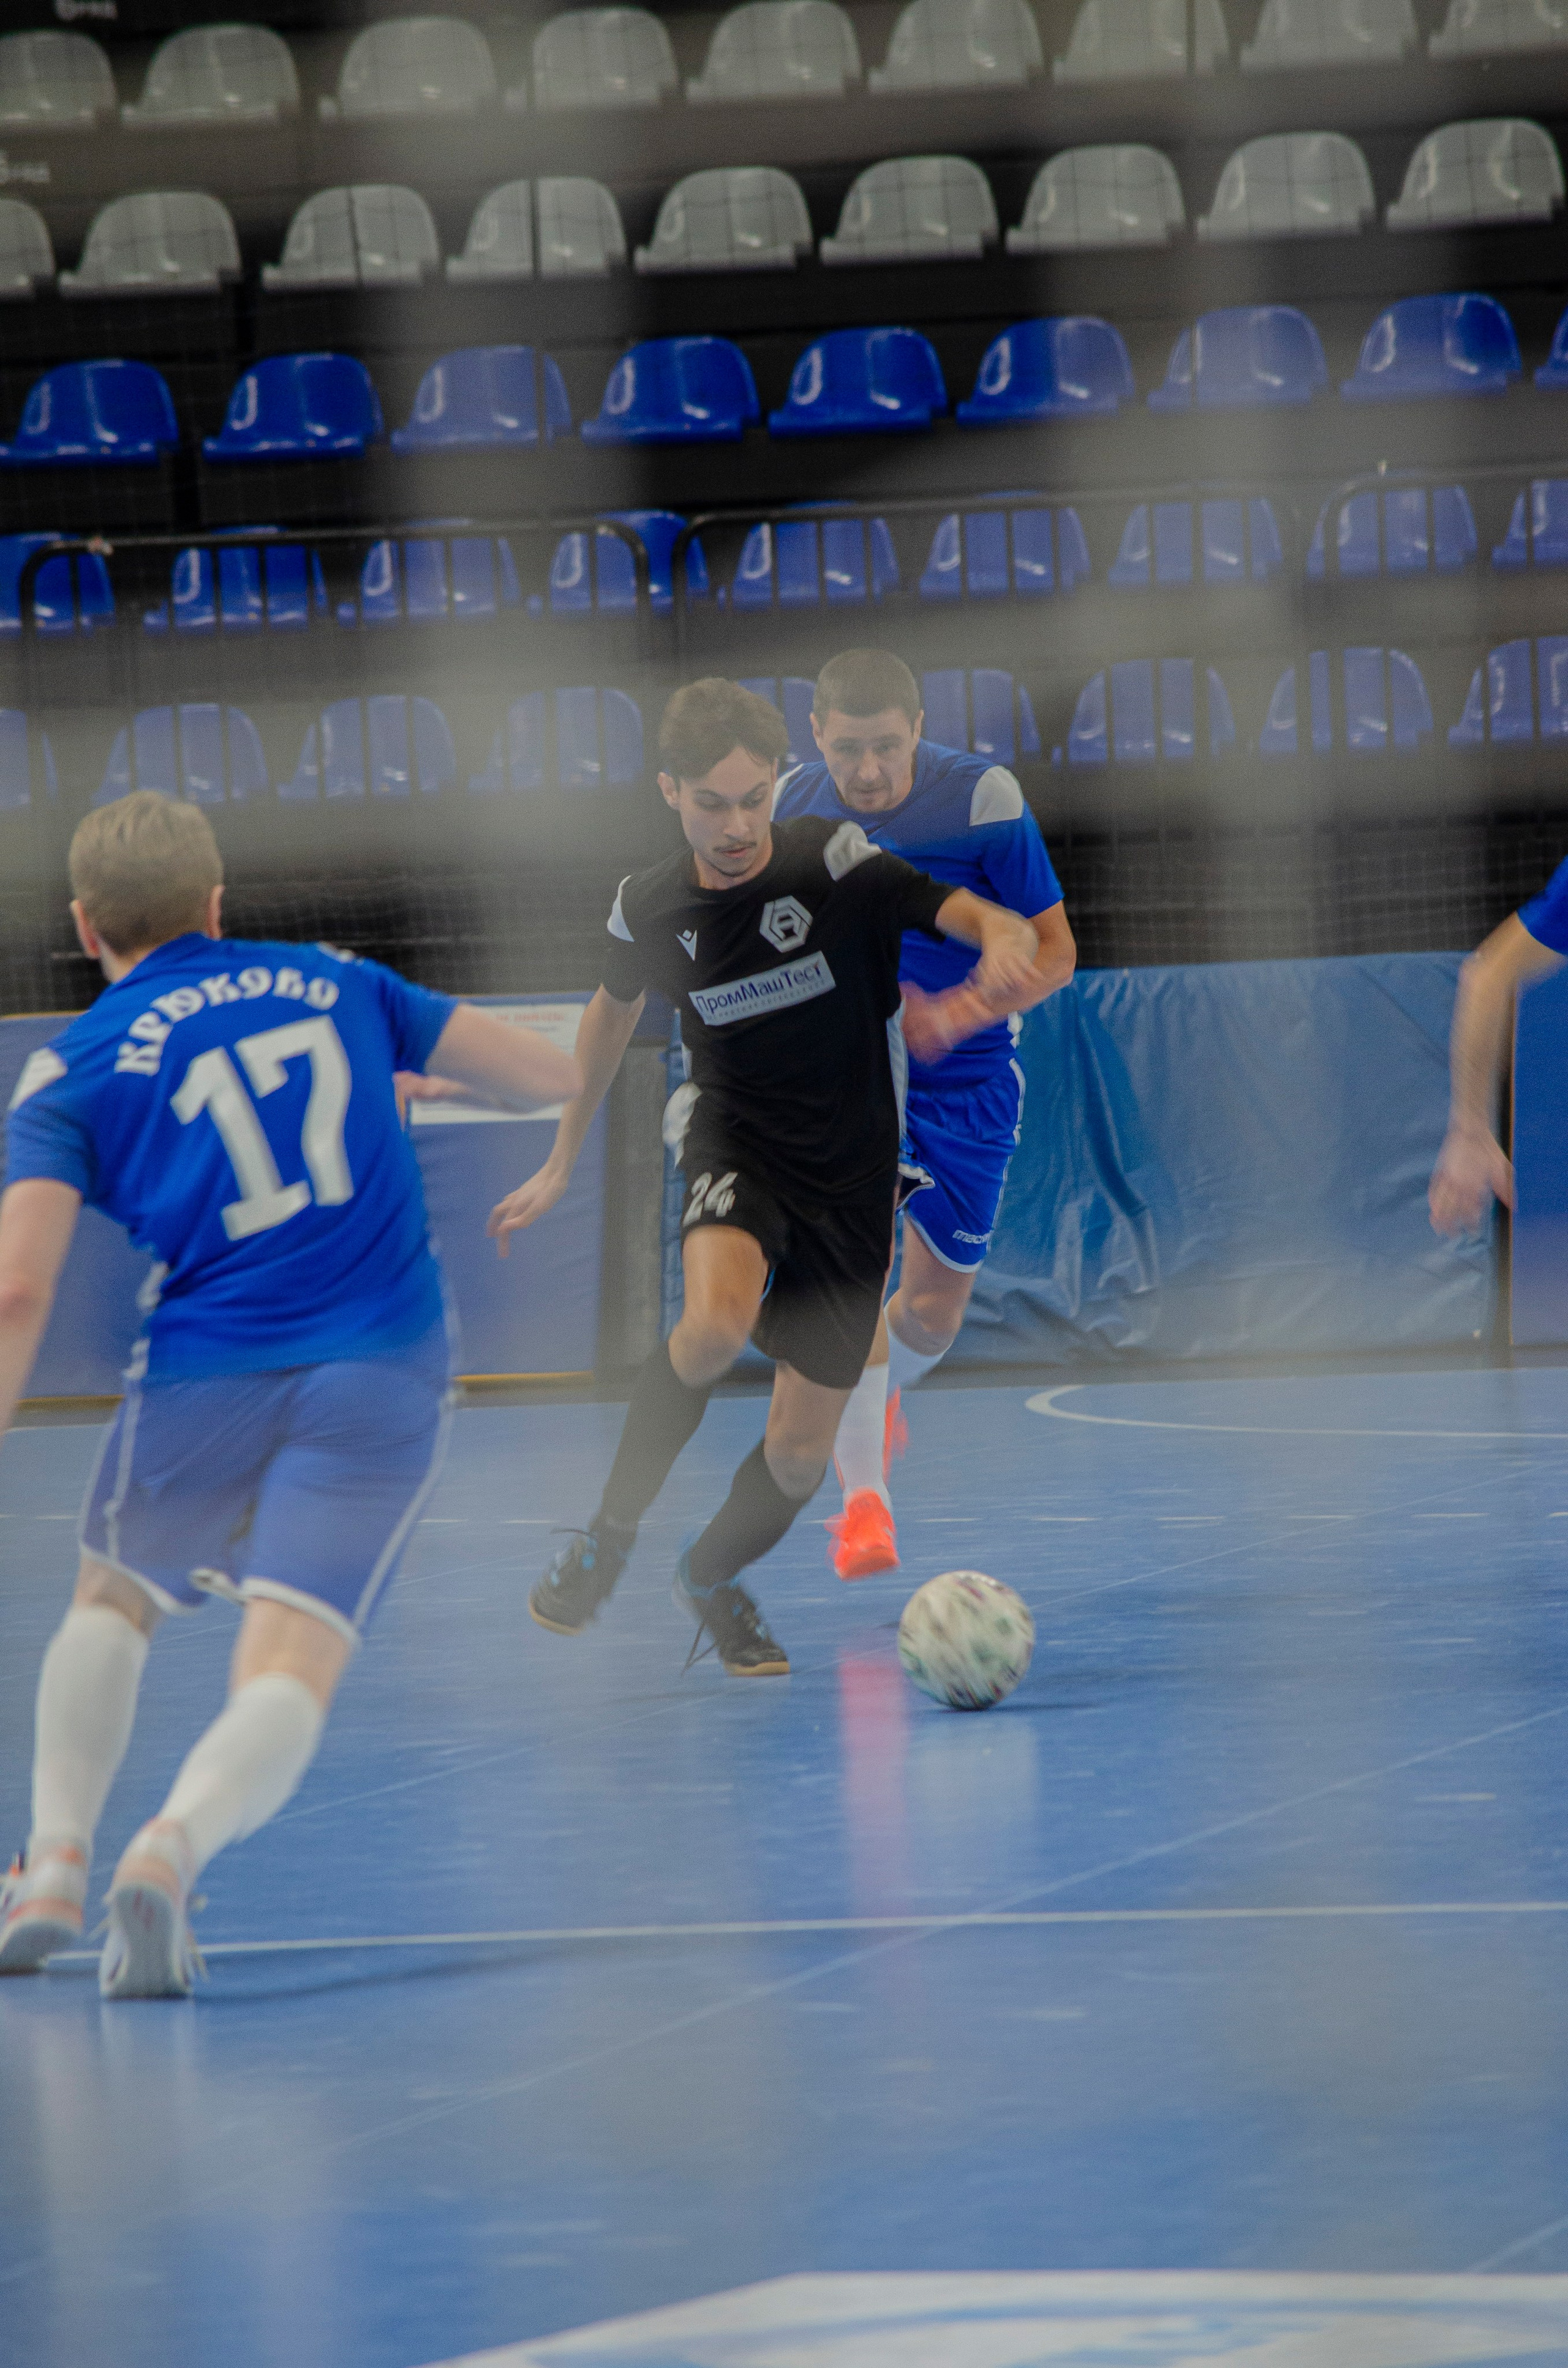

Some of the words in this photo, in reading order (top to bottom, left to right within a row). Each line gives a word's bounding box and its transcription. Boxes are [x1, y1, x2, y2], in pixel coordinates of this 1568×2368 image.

[695, 959, 823, 1015] ПромМашТест
[170, 1015, 354, 1243] 17
[682, 1171, 738, 1227] 24
